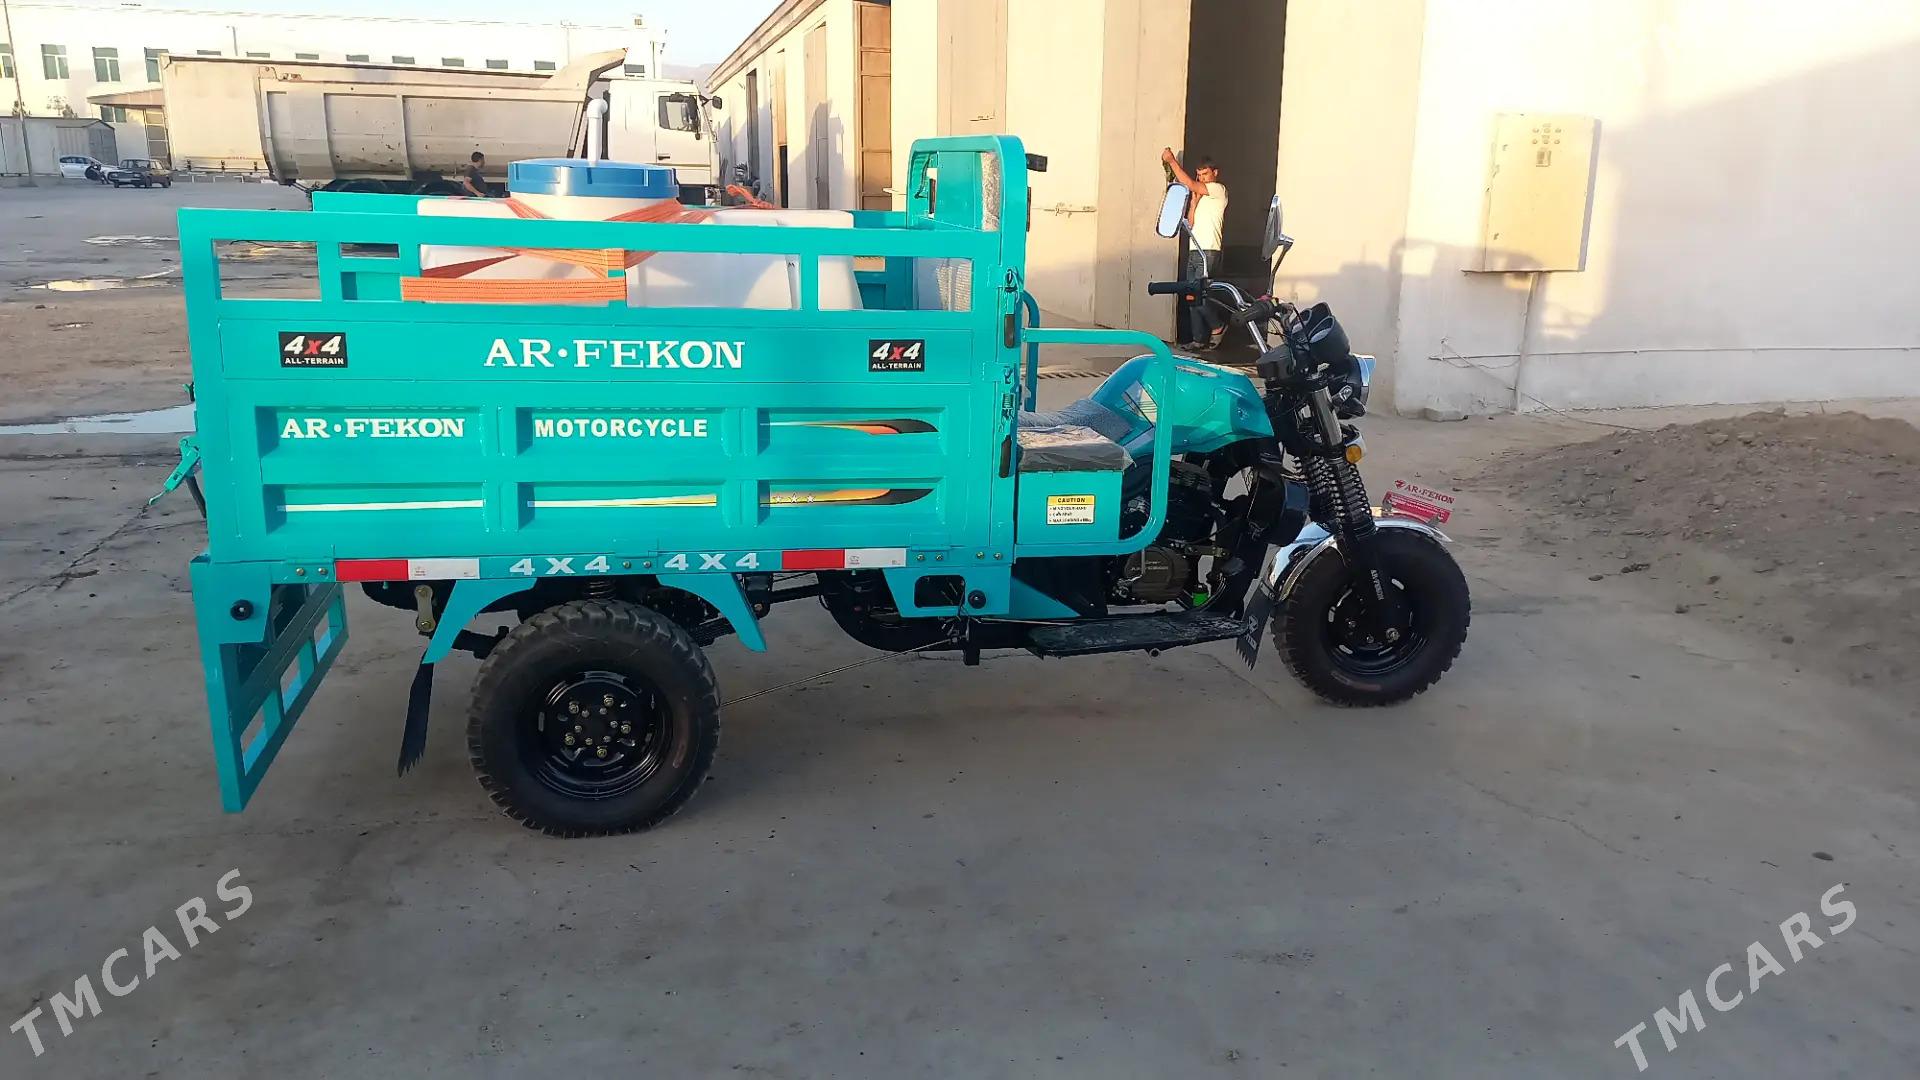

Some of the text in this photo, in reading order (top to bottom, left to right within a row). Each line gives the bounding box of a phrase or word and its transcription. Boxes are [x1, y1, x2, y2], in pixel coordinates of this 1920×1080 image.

[284, 336, 342, 354] 4x4
[872, 342, 922, 360] 4x4
[284, 357, 345, 365] ALL-TERRAIN
[534, 418, 708, 438] MOTORCYCLE
